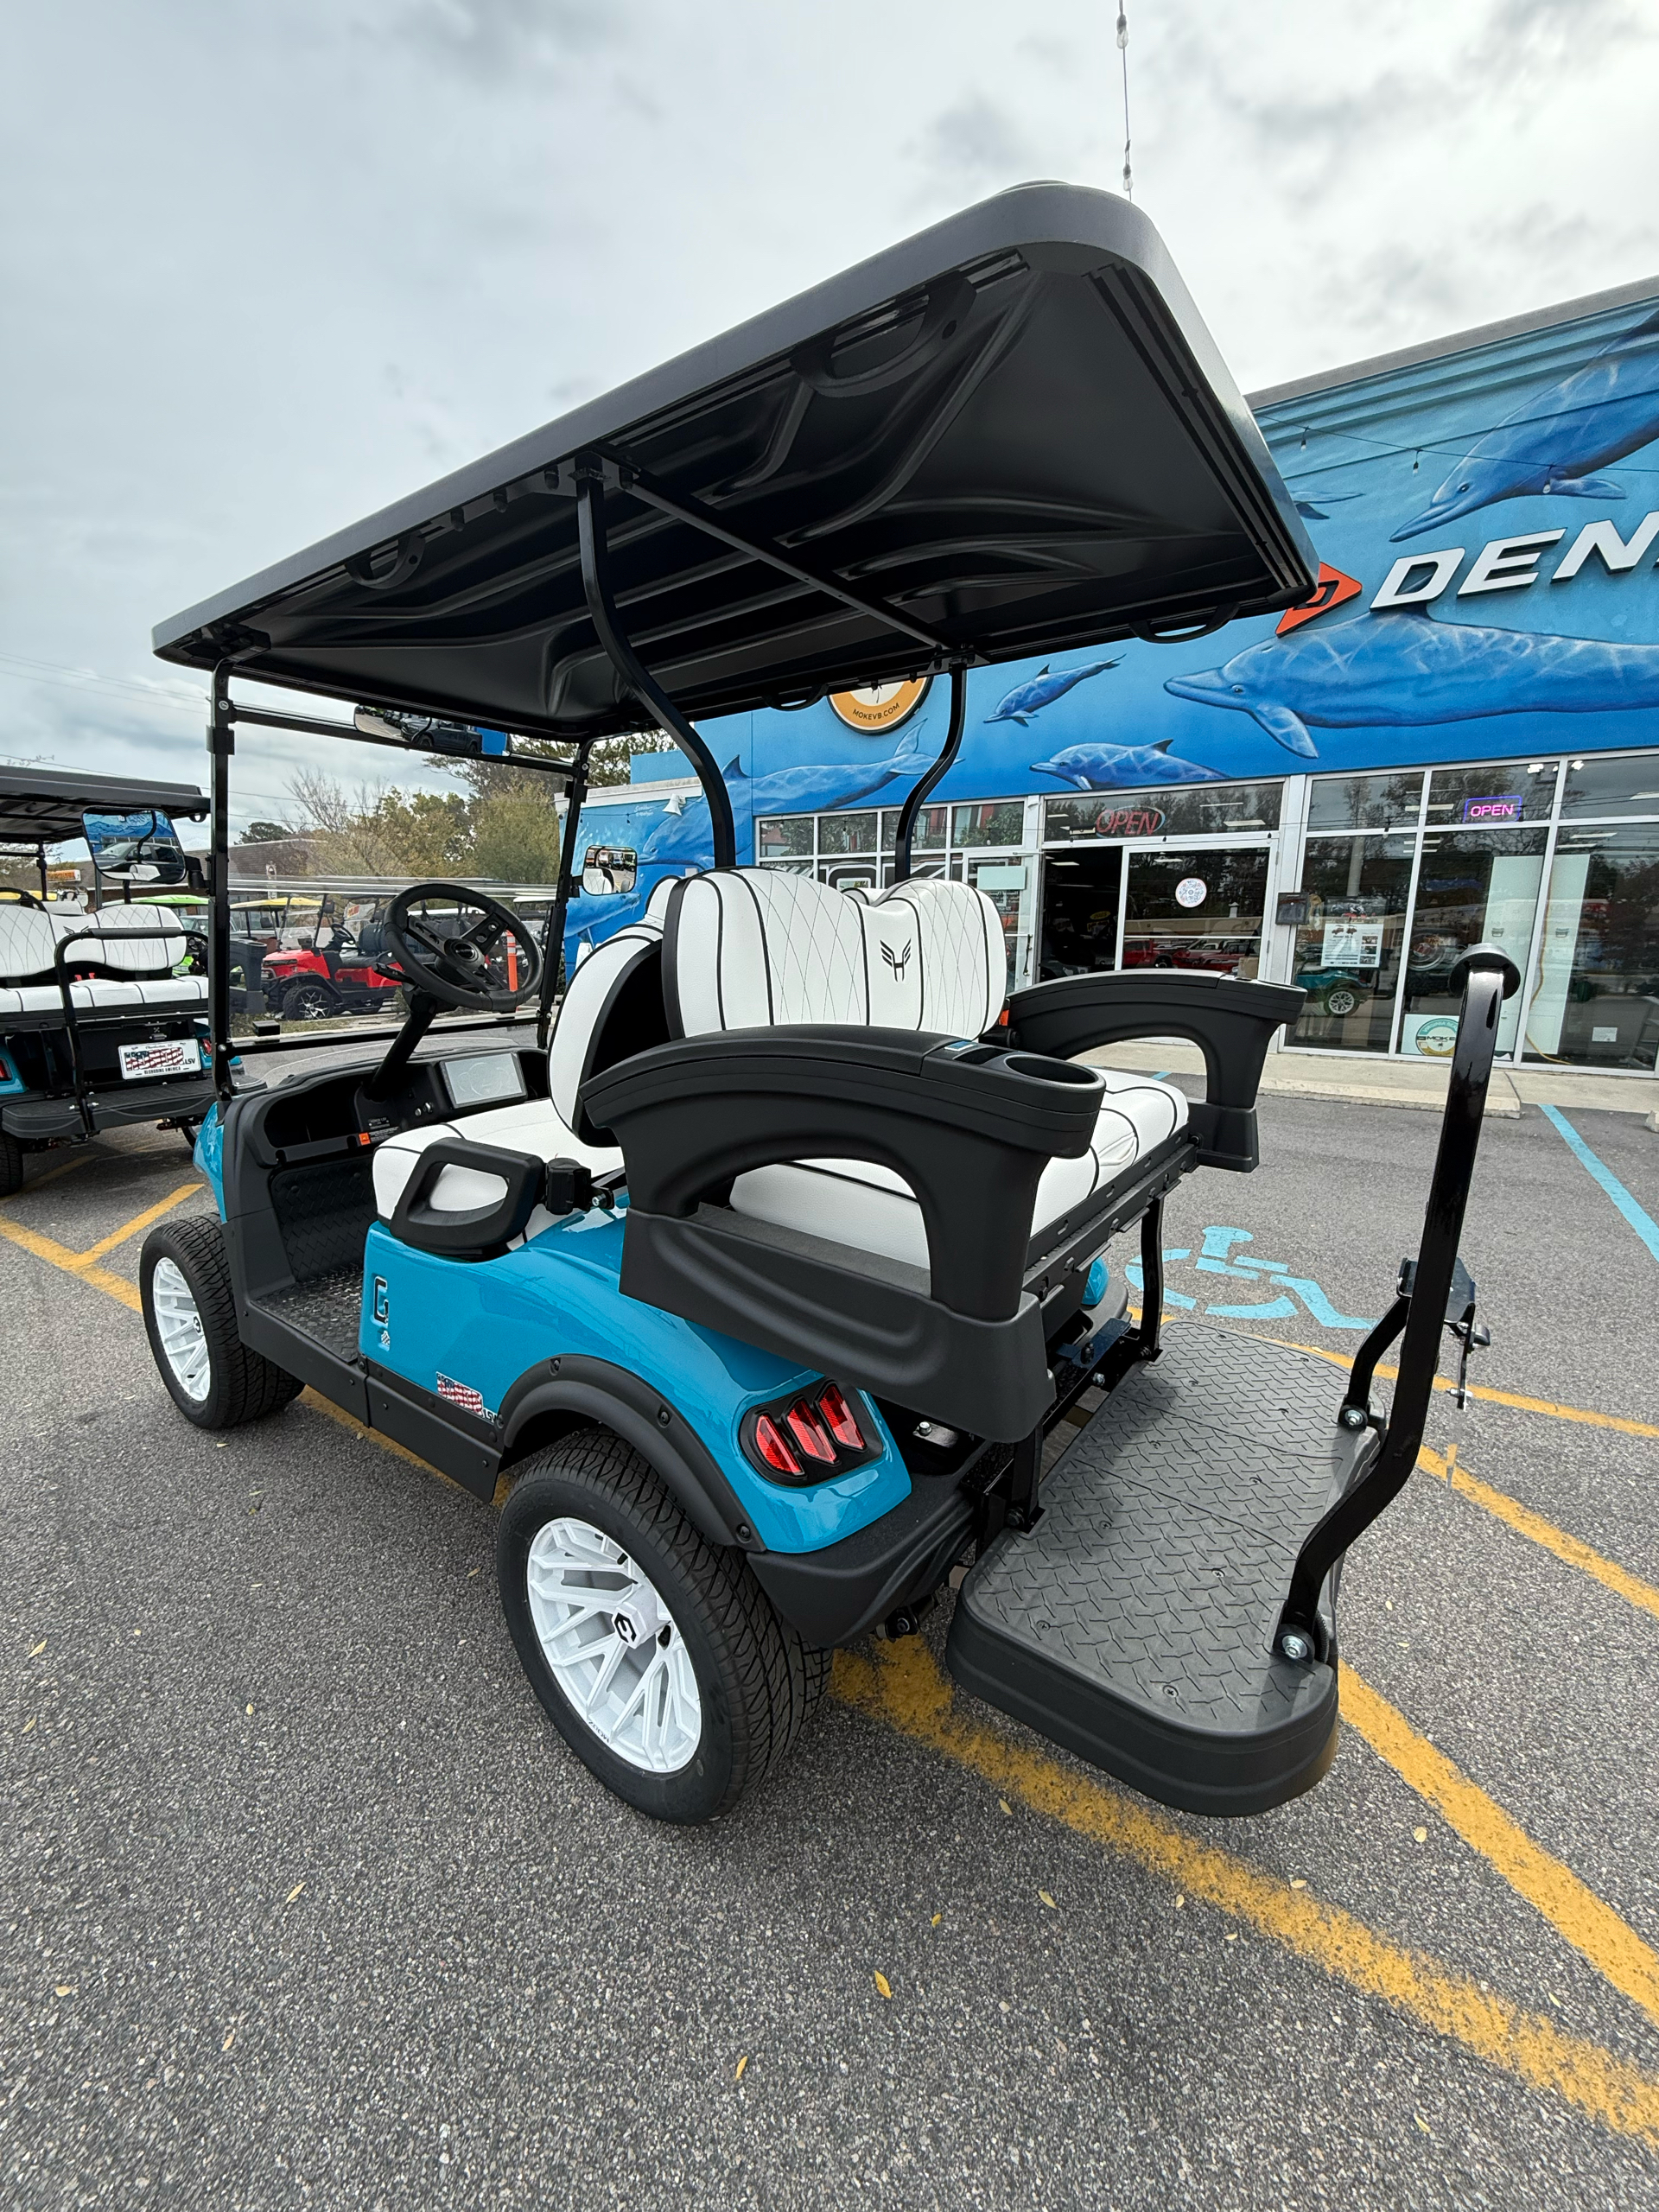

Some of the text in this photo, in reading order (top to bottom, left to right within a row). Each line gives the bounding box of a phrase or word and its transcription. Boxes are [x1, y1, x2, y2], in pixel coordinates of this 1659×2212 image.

[1369, 510, 1659, 610] DEN
[852, 702, 900, 721] MOKEVB.COM
[1470, 804, 1515, 817] OPEN
[1096, 809, 1160, 836] OPEN
[1446, 1021, 1458, 1033] BEA
